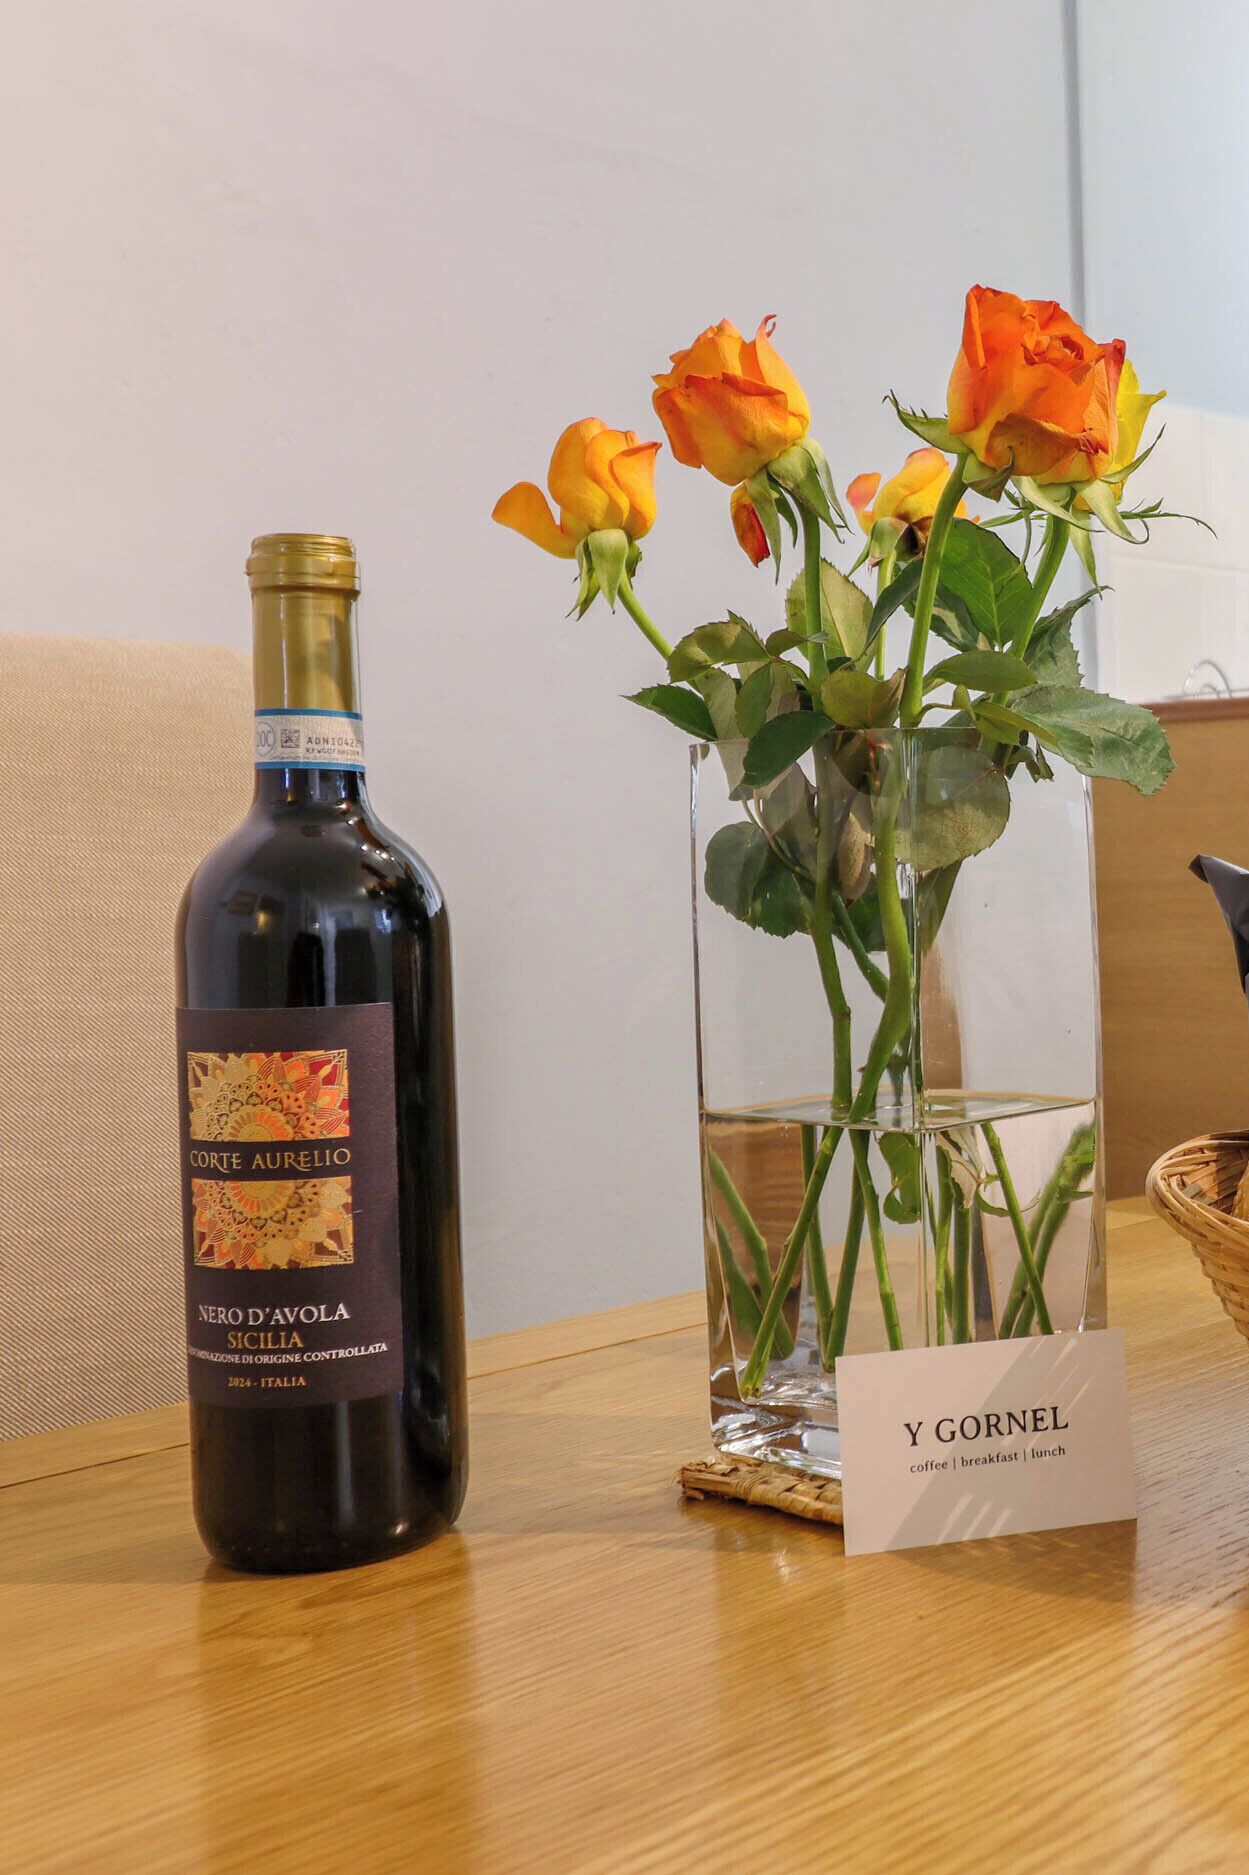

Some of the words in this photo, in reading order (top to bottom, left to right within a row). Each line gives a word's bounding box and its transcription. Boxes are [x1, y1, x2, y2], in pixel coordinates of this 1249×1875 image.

[190, 1150, 242, 1173] CORTE
[251, 1148, 350, 1172] AURELIO
[198, 1304, 243, 1325] NERO
[248, 1302, 351, 1326] D'AVOLA
[227, 1331, 305, 1350] SICILIA
[242, 1354, 253, 1364] DI
[254, 1353, 301, 1364] ORIGINE
[303, 1342, 388, 1362] CONTROLLATA
[228, 1376, 251, 1388] 2024
[261, 1376, 306, 1388] ITALIA
[904, 1421, 923, 1447] Y
[935, 1406, 1069, 1444] GORNEL
[910, 1460, 949, 1474] coffee
[961, 1451, 1019, 1468] breakfast
[1031, 1445, 1066, 1459] lunch
